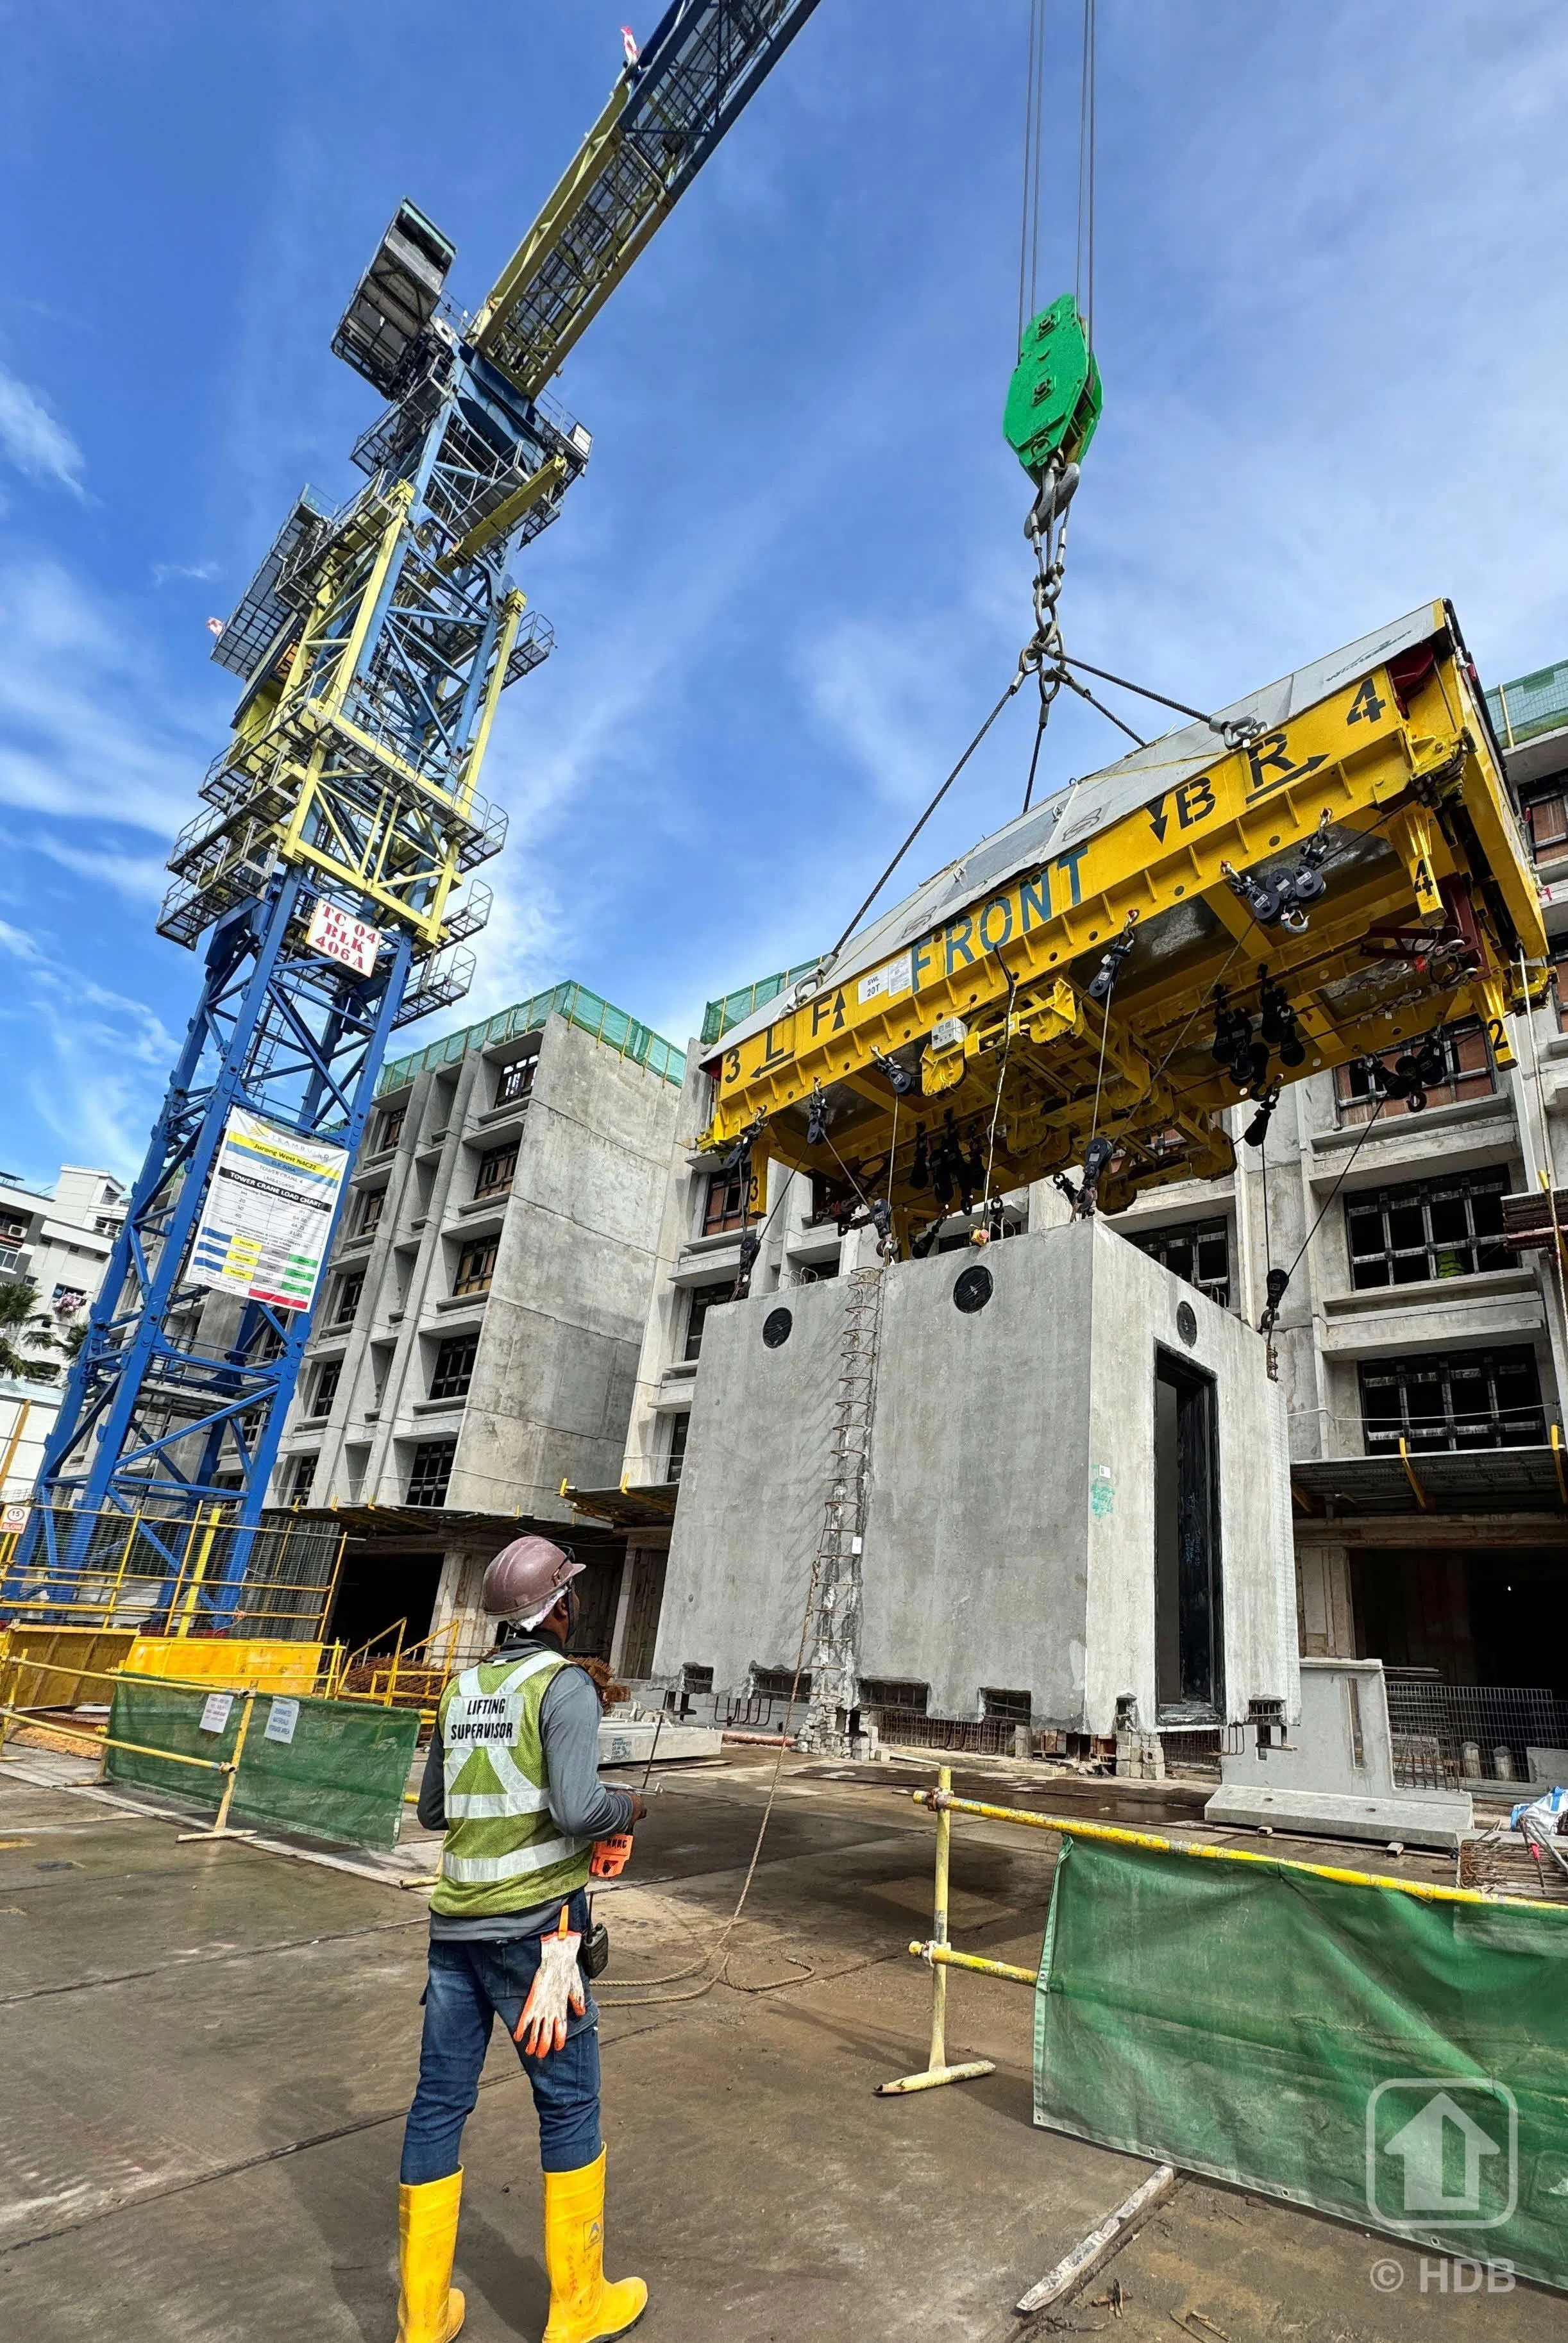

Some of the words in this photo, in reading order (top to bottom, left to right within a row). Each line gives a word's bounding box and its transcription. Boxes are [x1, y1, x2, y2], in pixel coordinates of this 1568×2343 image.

[1347, 678, 1386, 725] 4
[1248, 734, 1296, 788] R
[1176, 777, 1216, 830] B
[1413, 859, 1434, 897] 4
[323, 904, 347, 926] TC
[354, 924, 376, 944] 04
[911, 845, 1088, 994] FRONT
[315, 936, 364, 969] 406A
[325, 922, 364, 953] BLK
[866, 983, 880, 997] 20T
[867, 976, 879, 986] SWL
[812, 994, 832, 1038] F
[766, 1027, 784, 1062] L
[1488, 1019, 1509, 1052] 2
[725, 1048, 741, 1084] 3
[253, 1143, 278, 1156] Jurong
[278, 1151, 296, 1163] West
[230, 1172, 256, 1186] TOWER
[257, 1182, 280, 1194] CRANE
[280, 1189, 299, 1200] LOAD
[299, 1197, 323, 1208] CHART
[750, 1176, 759, 1202] 3
[467, 1698, 506, 1715] LIFTING
[450, 1722, 513, 1740] SUPERVISOR
